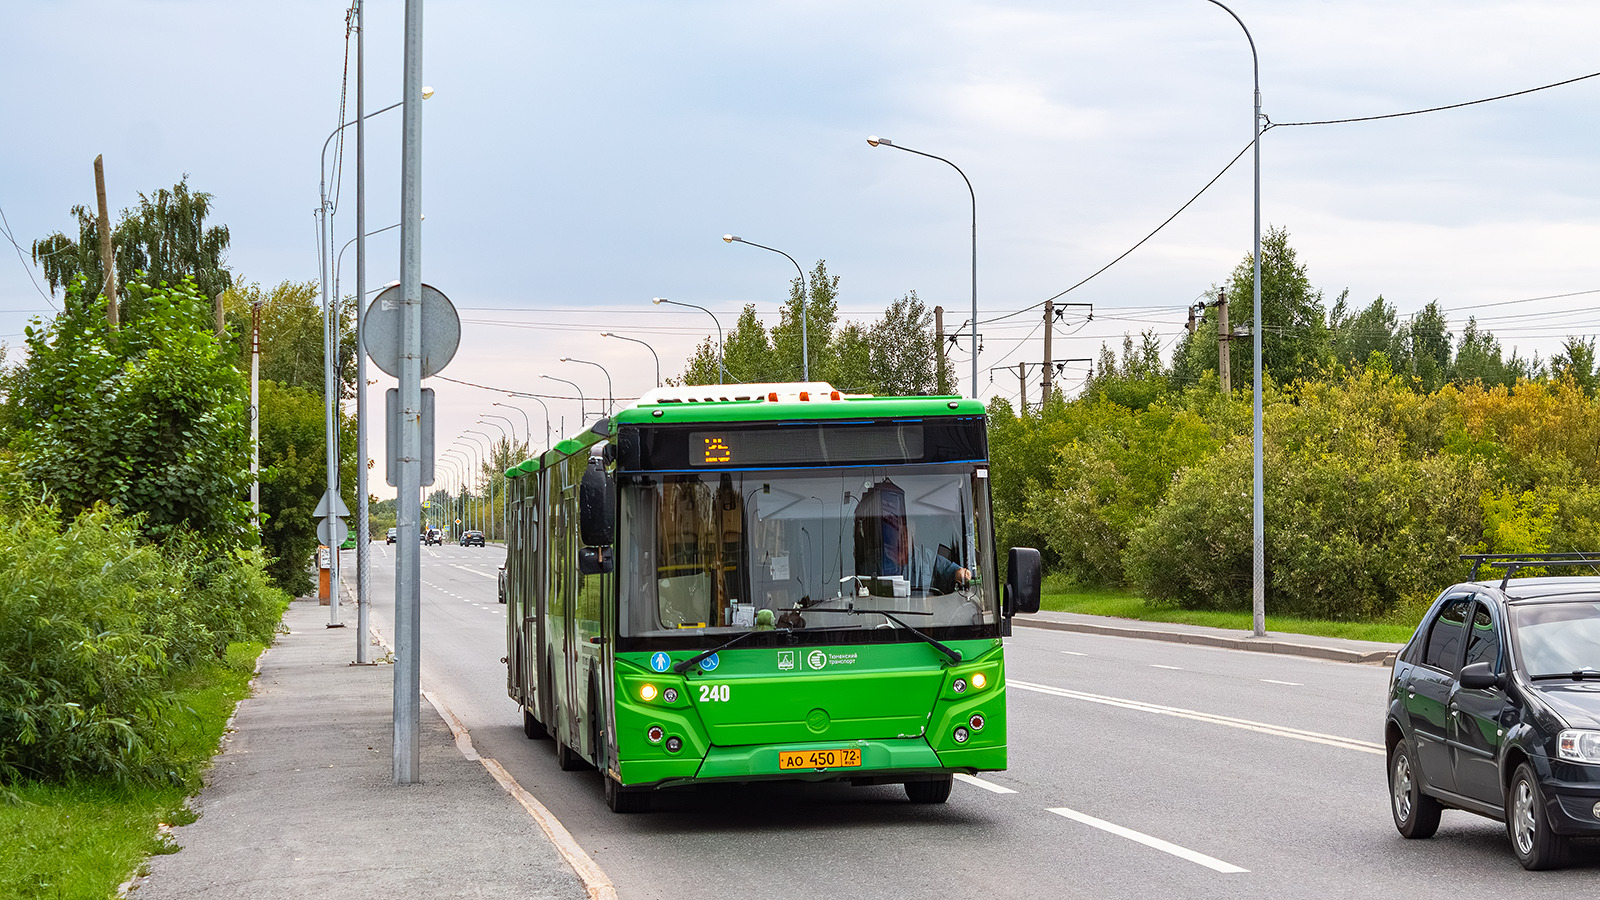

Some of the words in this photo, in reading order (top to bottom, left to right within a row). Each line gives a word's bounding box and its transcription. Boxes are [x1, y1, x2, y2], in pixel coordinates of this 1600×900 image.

[828, 653, 858, 661] Тюменский
[699, 685, 730, 702] 240
[809, 752, 835, 766] 450
[842, 750, 856, 761] 72
